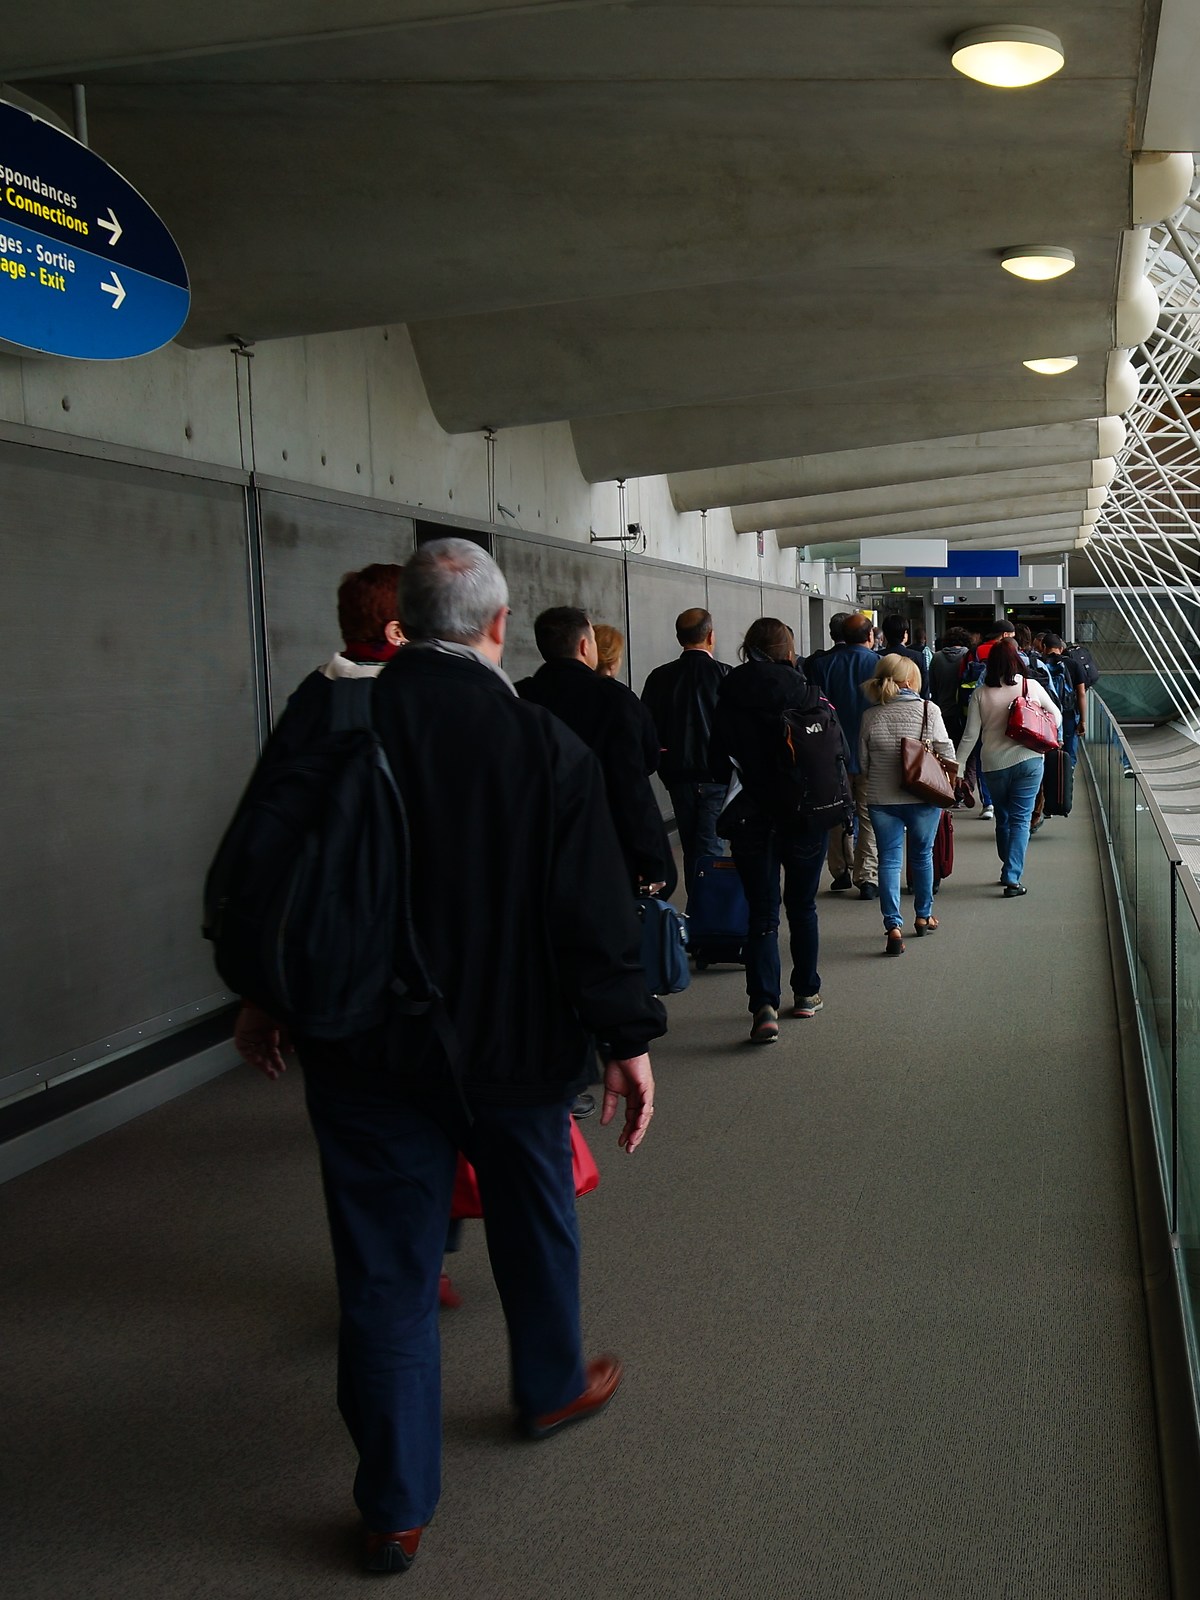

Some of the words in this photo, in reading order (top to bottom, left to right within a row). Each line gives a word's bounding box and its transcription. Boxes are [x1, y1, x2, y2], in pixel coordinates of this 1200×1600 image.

[0, 165, 77, 209] spondances
[6, 187, 89, 235] Connections
[0, 233, 23, 254] ges
[36, 244, 75, 273] Sortie
[0, 257, 26, 280] age
[39, 267, 66, 292] Exit
